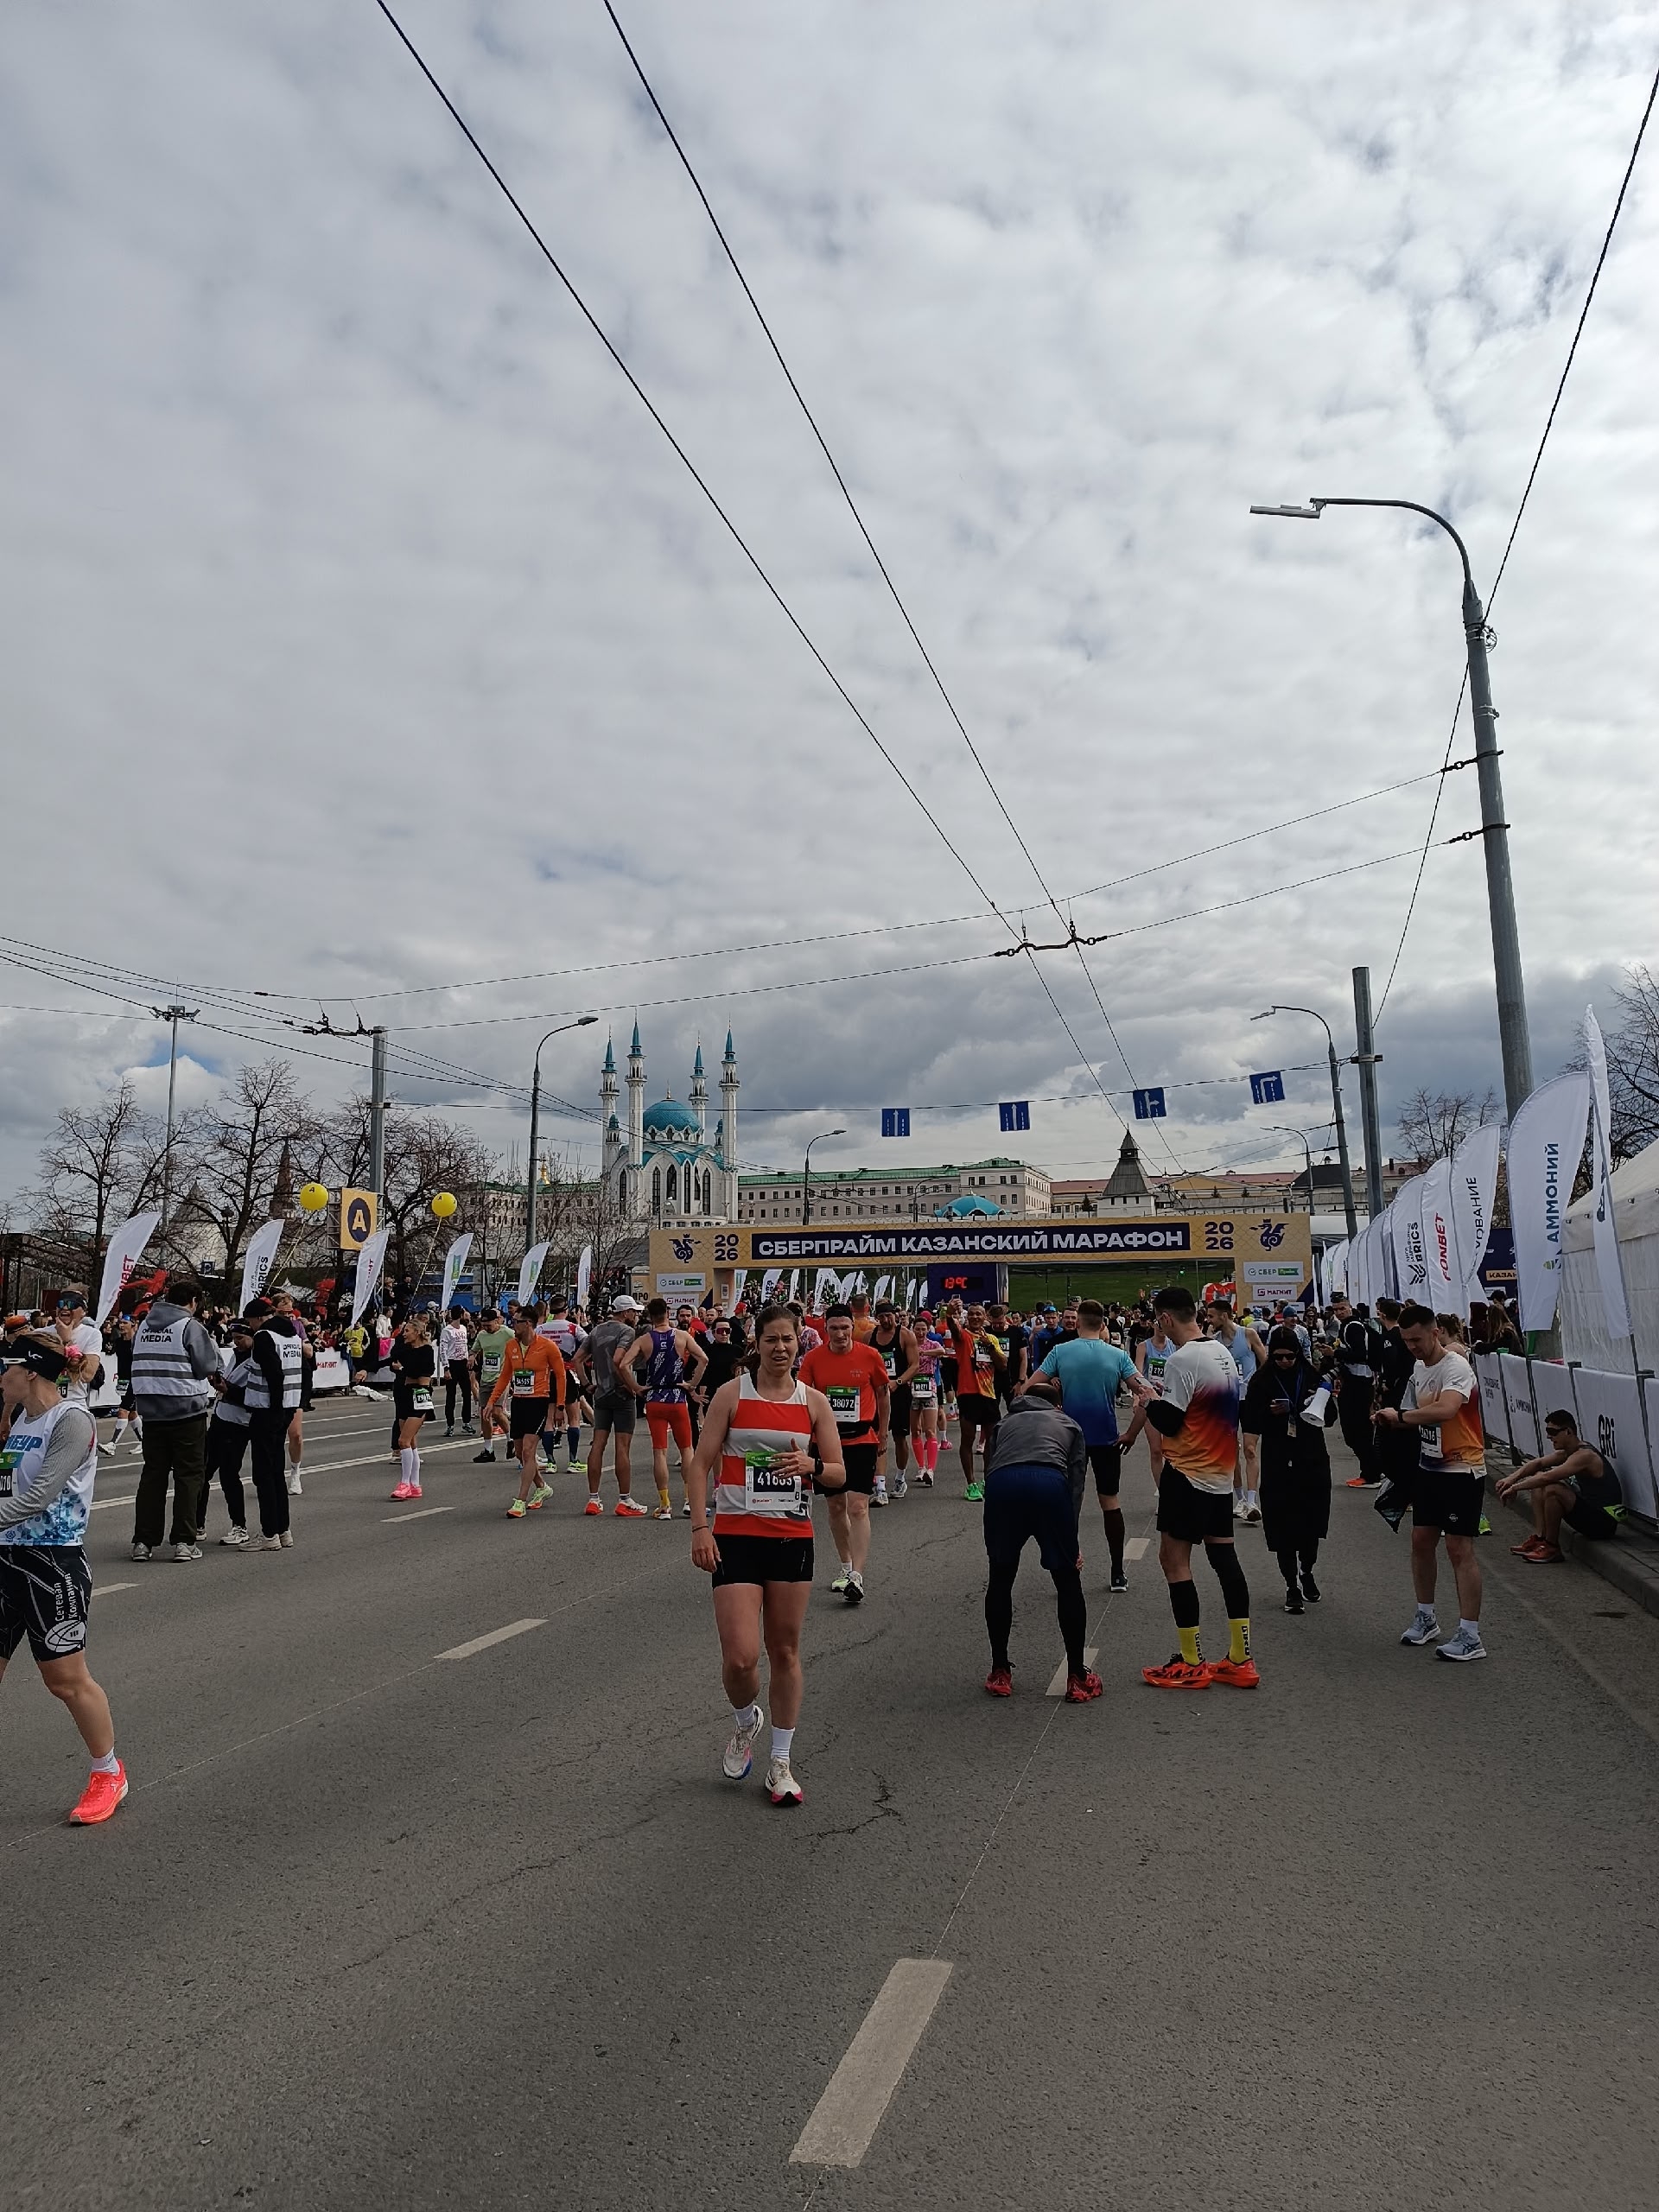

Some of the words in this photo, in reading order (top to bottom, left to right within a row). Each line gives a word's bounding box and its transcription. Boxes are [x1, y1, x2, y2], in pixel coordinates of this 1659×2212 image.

[1544, 1143, 1560, 1243] АММОНИЙ
[352, 1209, 367, 1232] A
[1205, 1221, 1235, 1235] 20
[714, 1233, 740, 1247] 20
[758, 1235, 896, 1255] СБЕРПРАЙМ
[901, 1230, 1048, 1252] КАЗАНСКИЙ
[1052, 1230, 1183, 1249] МАРАФОН
[1205, 1236, 1235, 1250] 26
[1411, 1222, 1423, 1262] BRICS
[1435, 1211, 1452, 1281] FONBET
[714, 1249, 739, 1262] 26
[832, 1398, 855, 1408] 38072
